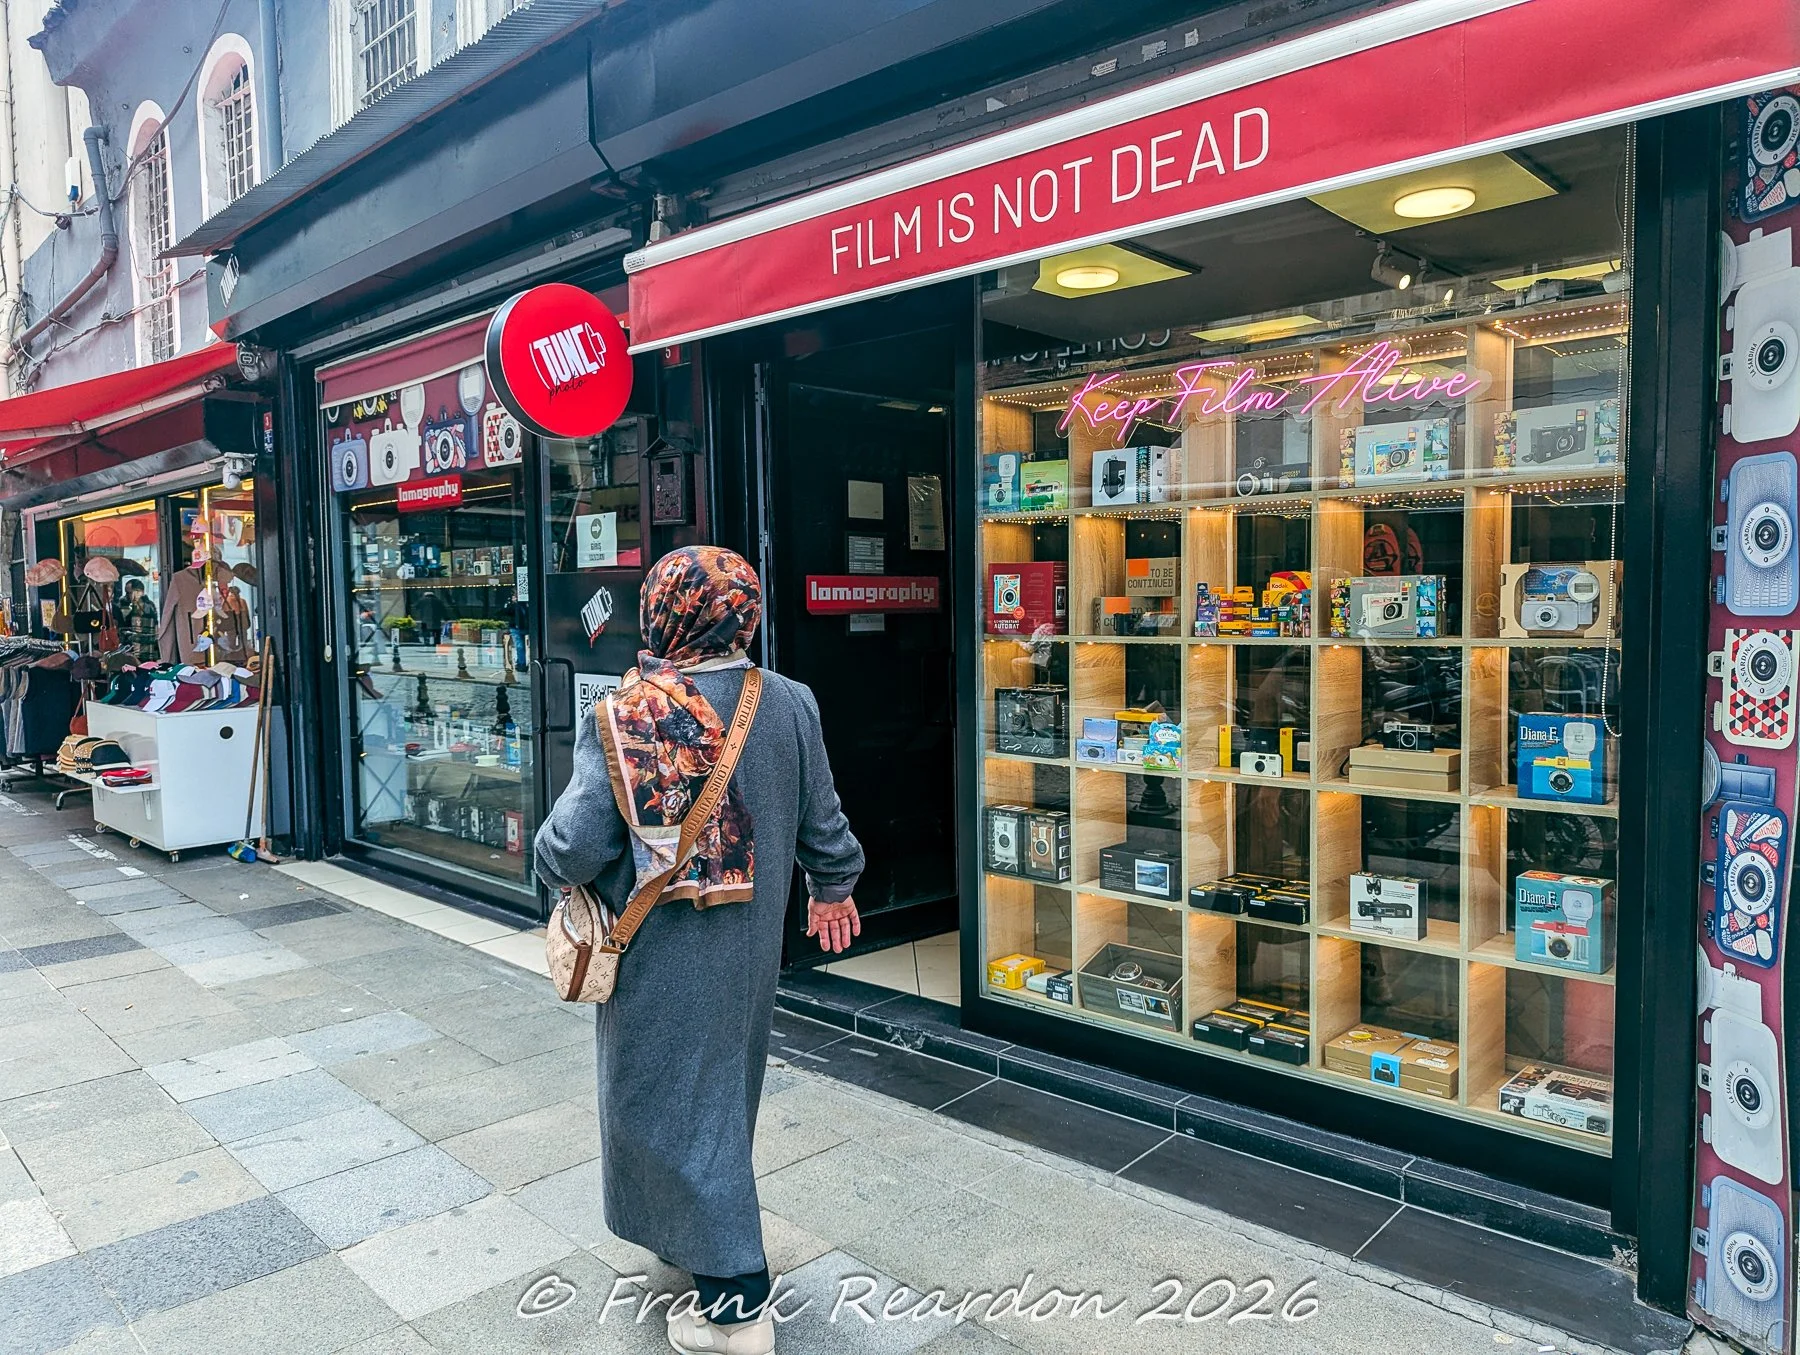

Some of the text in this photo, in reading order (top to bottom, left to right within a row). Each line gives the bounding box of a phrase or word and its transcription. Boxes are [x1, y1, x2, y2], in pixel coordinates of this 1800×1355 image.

[830, 106, 1270, 276] FILM IS NOT DEAD
[1748, 343, 1758, 378] LA SARDINA
[548, 371, 588, 404] photo
[1059, 341, 1481, 442] Keep Film Alive
[398, 480, 459, 502] lomography
[1743, 517, 1755, 554] LA SARDINA
[1127, 578, 1174, 589] CONTINUED
[1150, 567, 1174, 578] TO BE
[811, 581, 935, 604] lomography
[1739, 643, 1755, 687] LA SARDINA
[736, 689, 757, 730] VUITTON
[1519, 726, 1548, 741] Diana
[682, 764, 730, 839] LOUIS VUITTON
[1729, 862, 1741, 887] SARDINA
[1518, 888, 1546, 905] Diana
[1726, 1071, 1735, 1094] SARDINA
[1725, 1239, 1740, 1276] LA SARDINA
